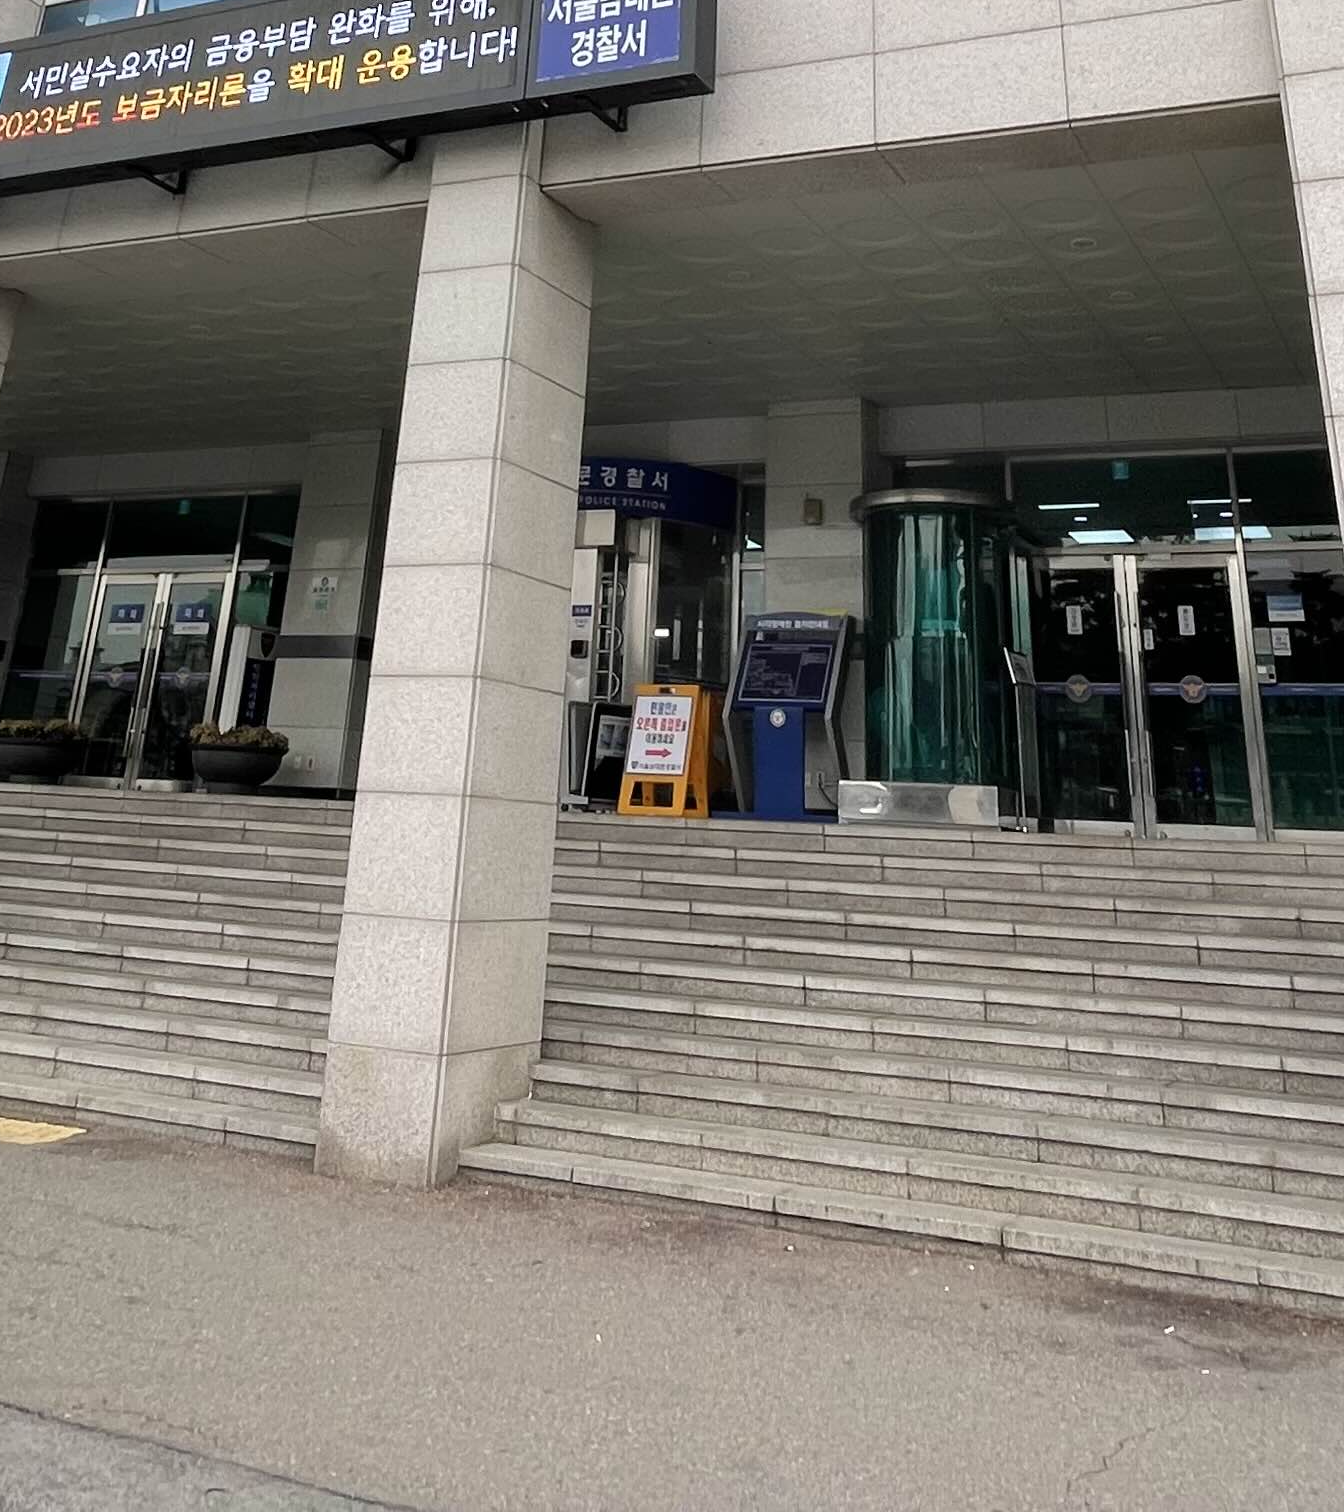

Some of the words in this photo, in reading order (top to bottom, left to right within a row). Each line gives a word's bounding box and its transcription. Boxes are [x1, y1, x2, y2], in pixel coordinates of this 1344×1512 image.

[19, 38, 196, 100] 서민실수요자의
[205, 16, 317, 68] 금융부담
[328, 0, 416, 45] 완화를
[111, 68, 276, 123] 보금자리론을
[287, 54, 345, 95] 확대
[356, 23, 518, 84] 운용합니다!
[570, 19, 648, 68] 경찰서
[621, 497, 667, 511] STATION
